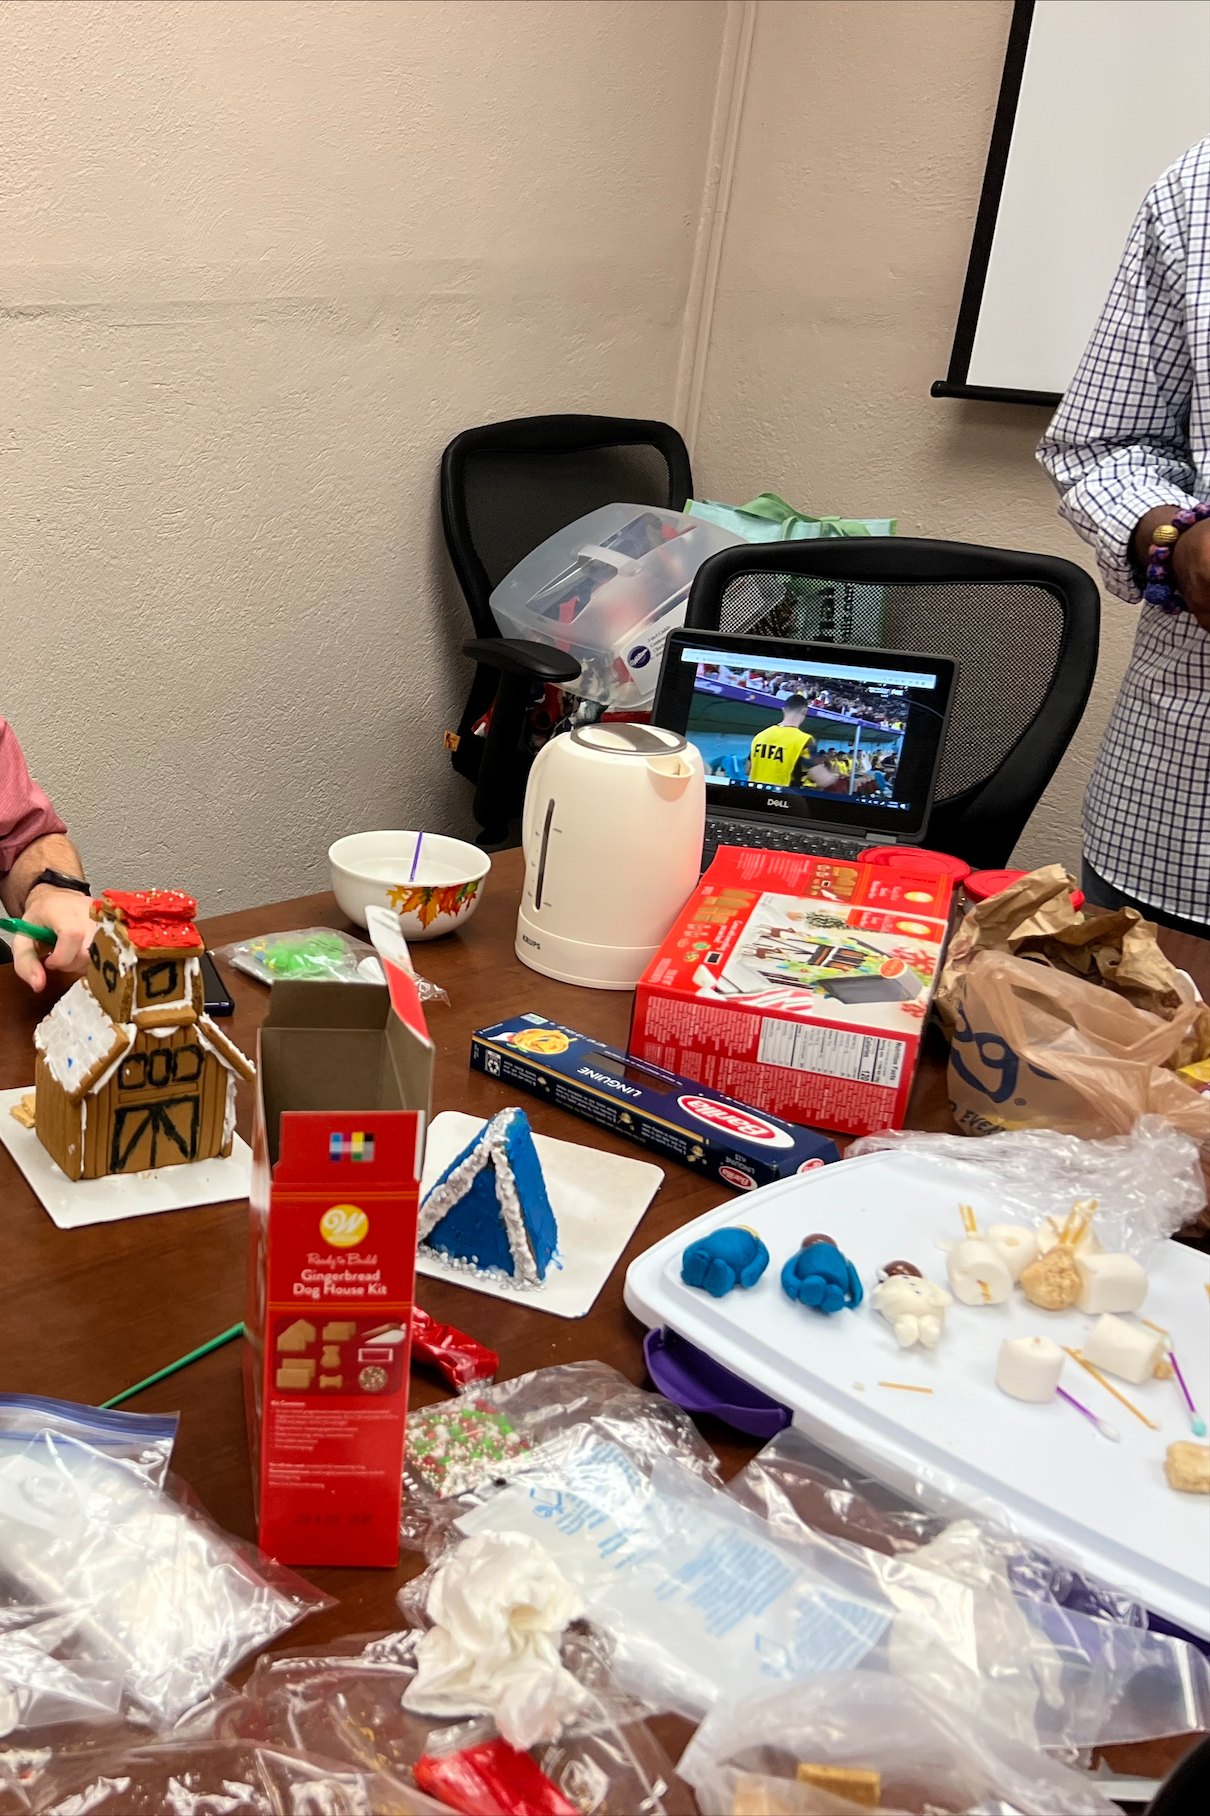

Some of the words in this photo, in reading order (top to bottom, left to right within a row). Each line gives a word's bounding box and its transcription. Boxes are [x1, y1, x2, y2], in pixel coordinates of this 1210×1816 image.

[753, 743, 783, 763] FIFA
[767, 798, 789, 809] DELL
[522, 934, 541, 950] KRUPS
[576, 1066, 643, 1097] LINGUINE
[686, 1099, 770, 1137] Barilla
[724, 1155, 756, 1175] LINGUINE
[721, 1168, 750, 1188] Barilla
[306, 1252, 336, 1270] Ready
[336, 1255, 347, 1265] to
[345, 1252, 378, 1266] Build
[300, 1269, 382, 1285] Gingerbread
[292, 1282, 321, 1300] Dog
[323, 1282, 365, 1296] House
[367, 1282, 388, 1296] Kit
